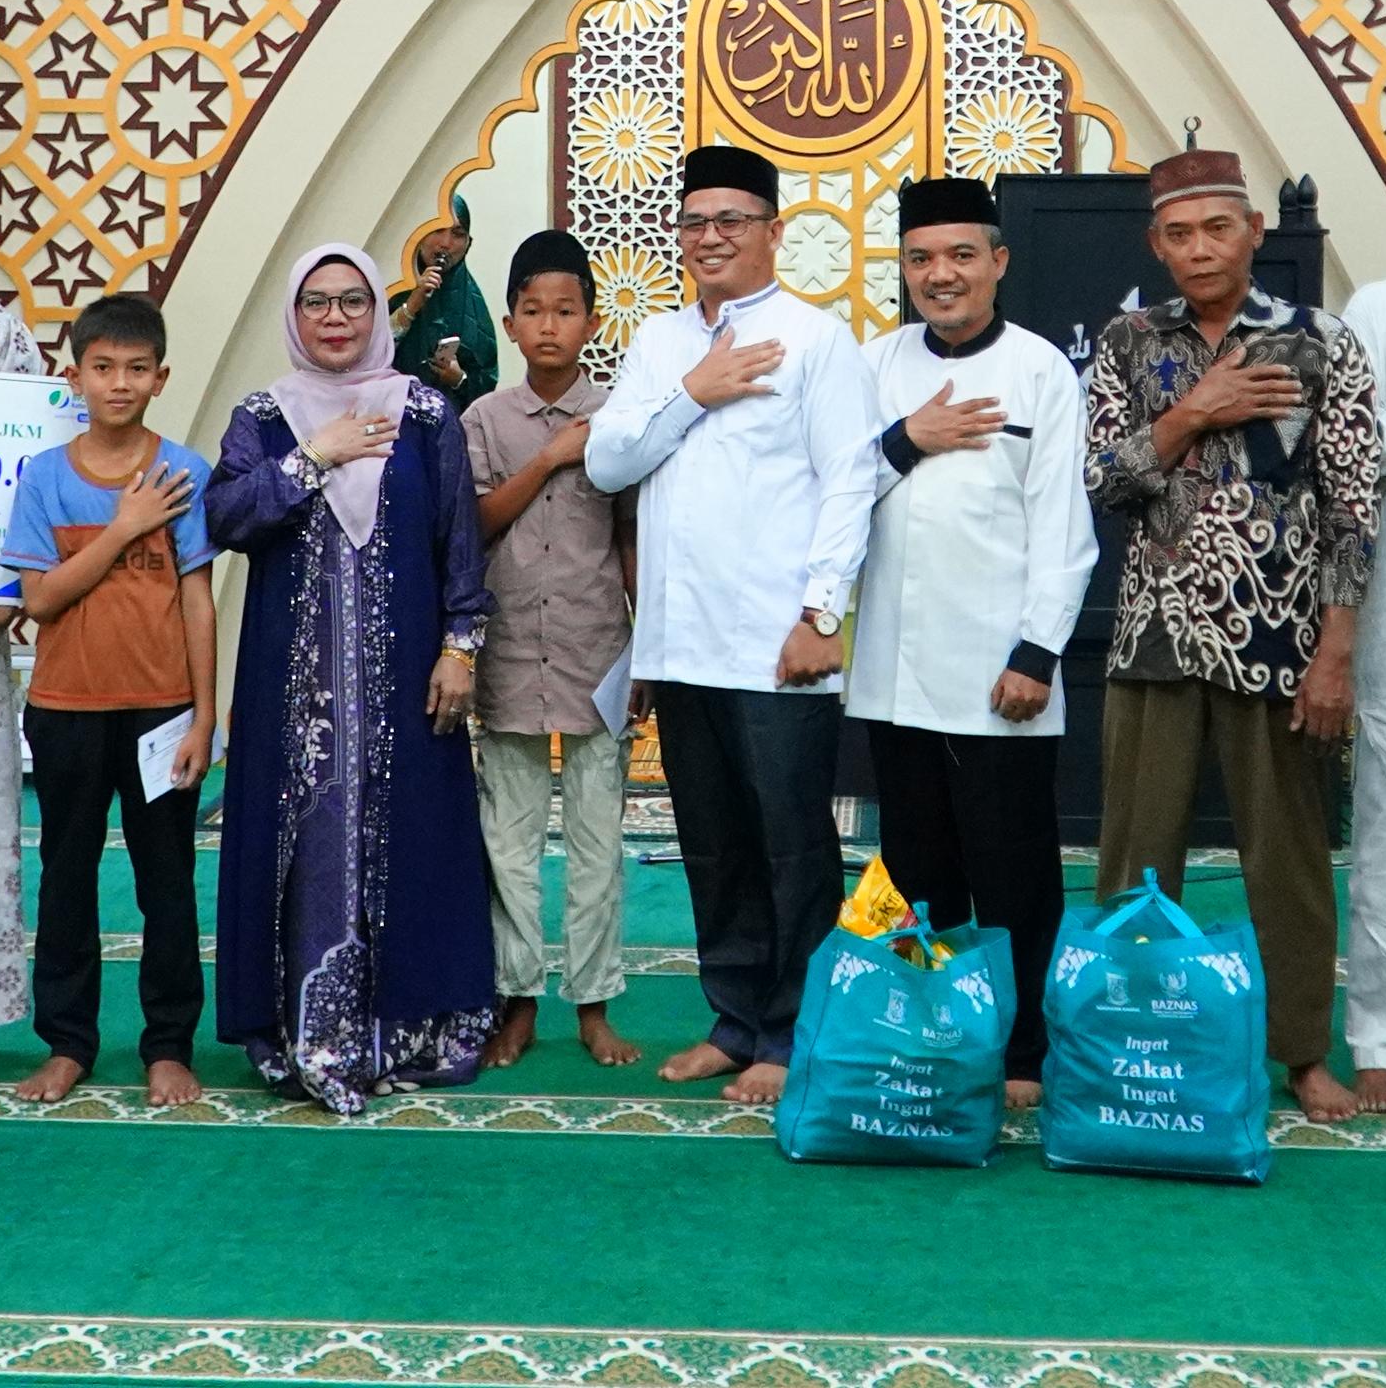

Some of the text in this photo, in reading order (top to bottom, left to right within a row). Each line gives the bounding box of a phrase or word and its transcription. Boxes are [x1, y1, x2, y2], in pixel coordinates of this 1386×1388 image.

[1151, 999, 1199, 1012] BAZNAS
[922, 1027, 964, 1041] BAZNAS
[1125, 1035, 1170, 1055] Ingat
[890, 1054, 934, 1076] Ingat
[1112, 1056, 1186, 1081] Zakat
[874, 1070, 946, 1099] Zakat
[1121, 1083, 1179, 1107] Ingat
[879, 1093, 934, 1118] Ingat
[850, 1112, 955, 1138] BAZNAS
[1098, 1105, 1206, 1134] BAZNAS
